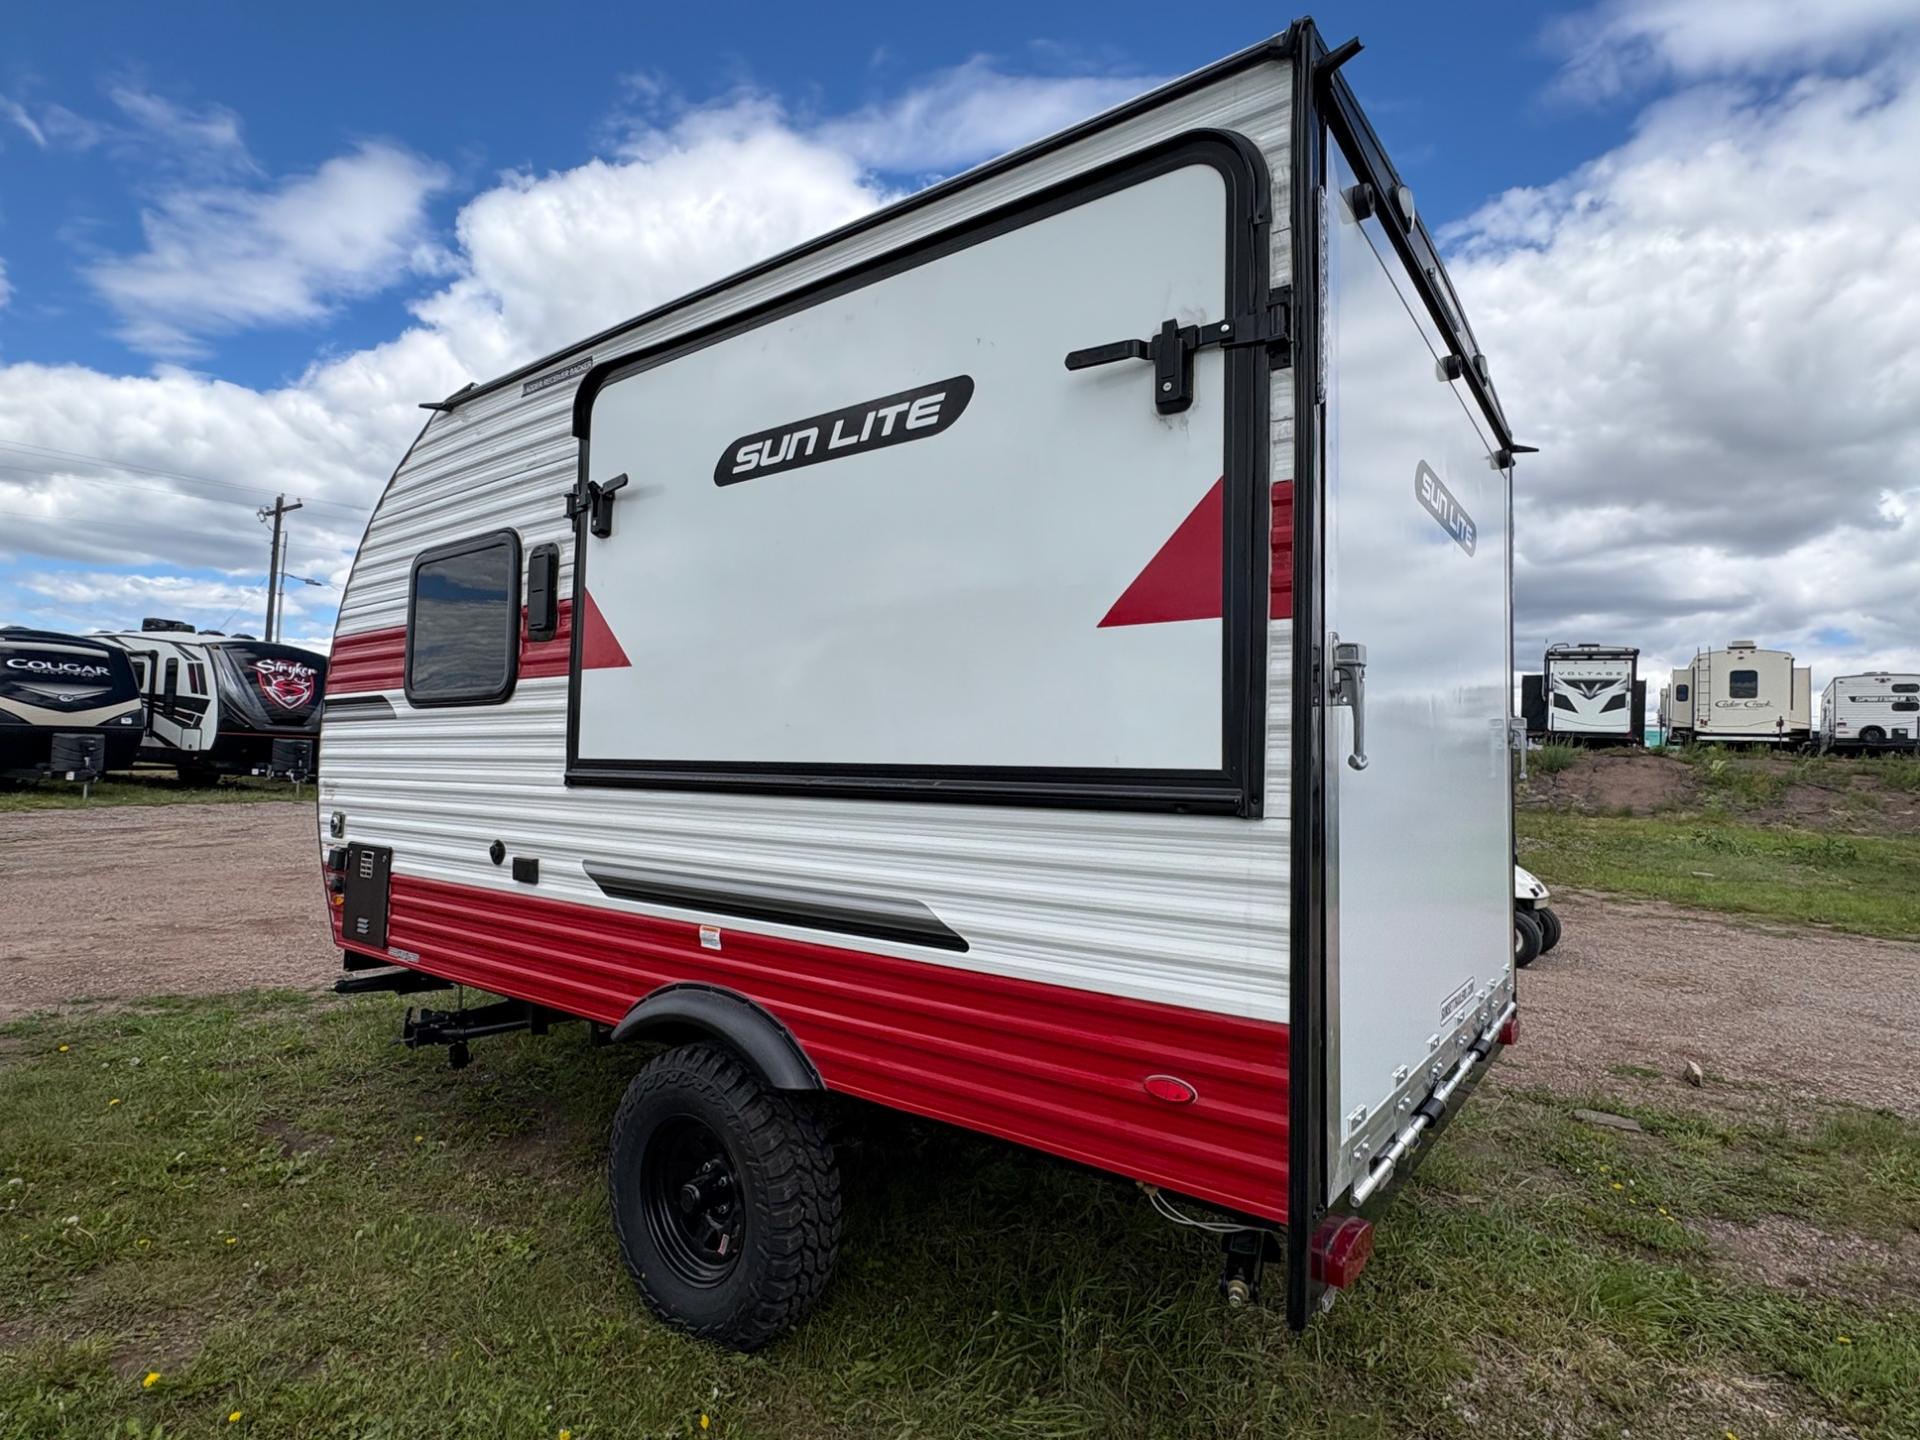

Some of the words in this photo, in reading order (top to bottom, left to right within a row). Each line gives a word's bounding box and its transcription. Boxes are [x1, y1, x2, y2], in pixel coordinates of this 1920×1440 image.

[732, 427, 819, 474] SUN
[828, 392, 946, 450] LITE
[1421, 472, 1448, 520] SUN
[1449, 505, 1473, 548] LITE
[6, 658, 111, 676] COUGAR
[253, 658, 318, 680] Stryker
